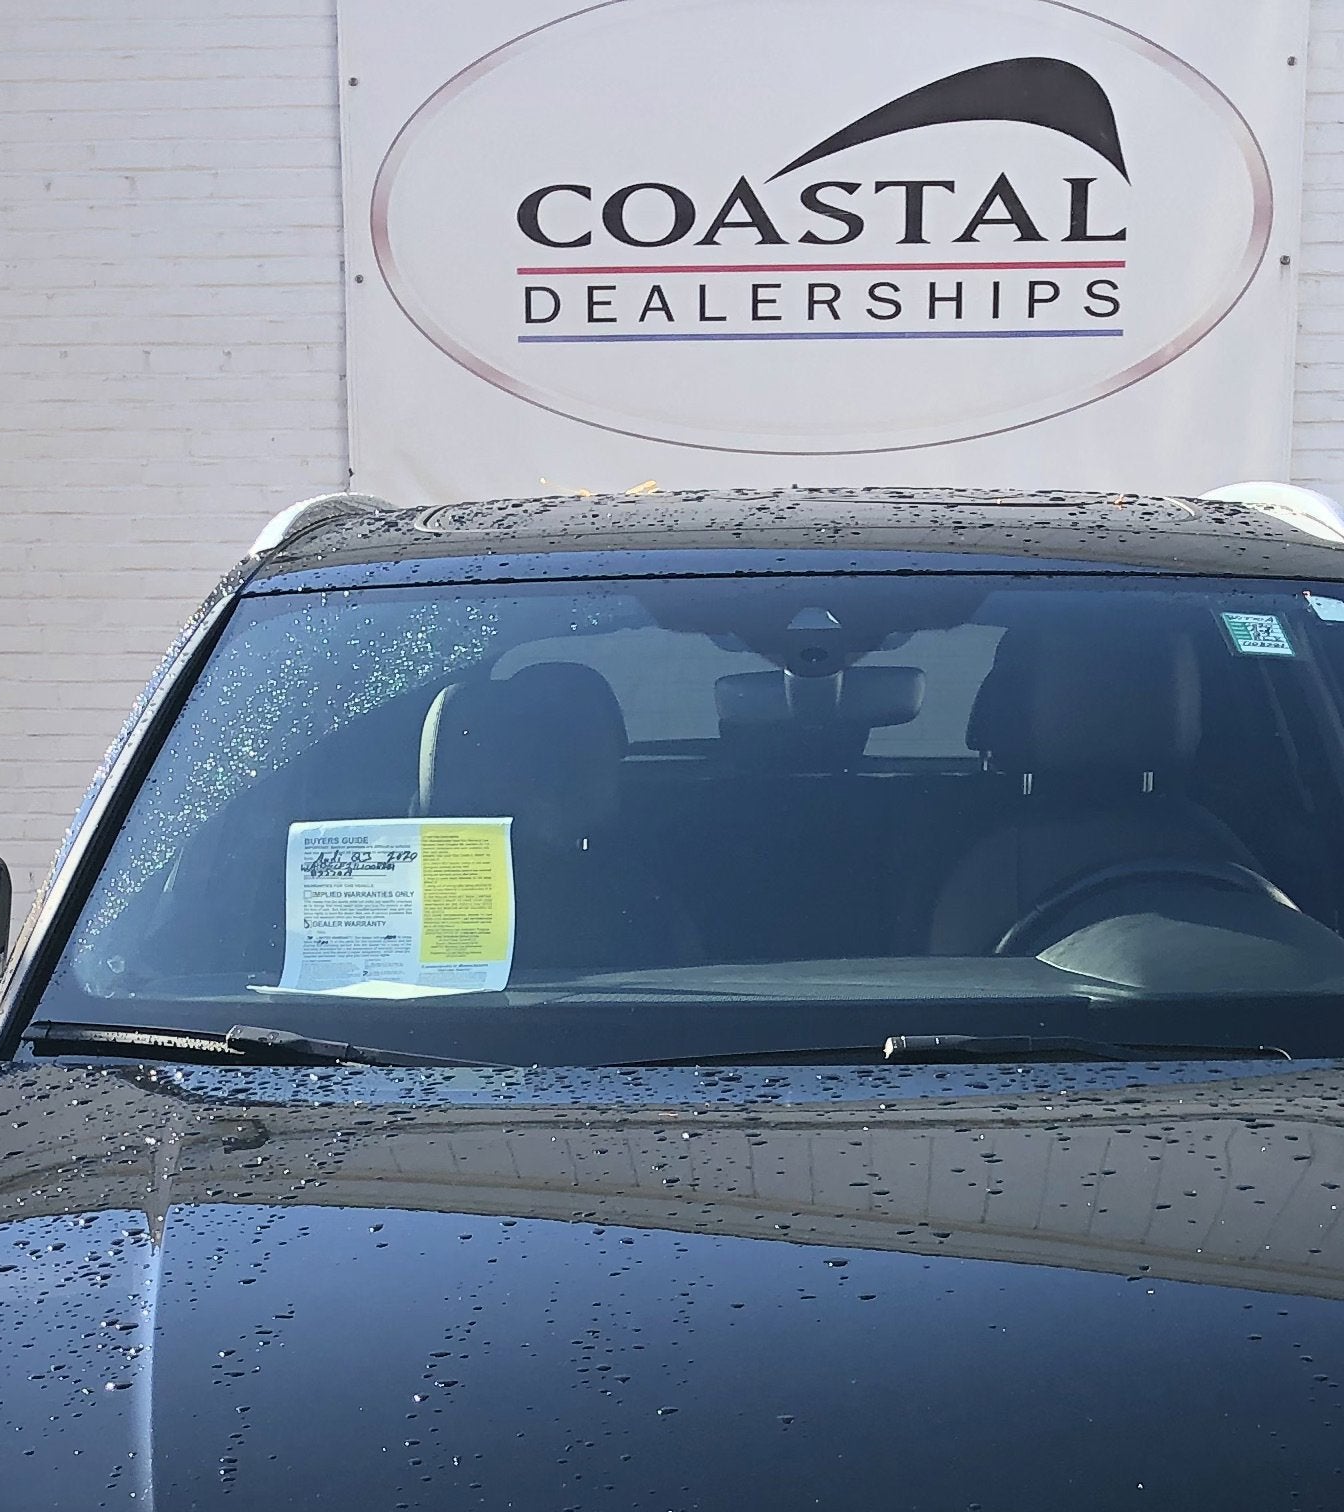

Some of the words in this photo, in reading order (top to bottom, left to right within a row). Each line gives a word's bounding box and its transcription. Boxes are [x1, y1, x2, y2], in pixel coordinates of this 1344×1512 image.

[516, 171, 1128, 249] COASTAL
[524, 278, 1123, 325] DEALERSHIPS
[304, 836, 340, 846] BUYERS
[341, 836, 369, 845] GUIDE
[311, 890, 342, 898] IMPLIED
[344, 890, 393, 898] WARRANTIES
[394, 890, 415, 898] ONLY
[312, 920, 343, 928] DEALER
[344, 920, 387, 928] WARRANTY
